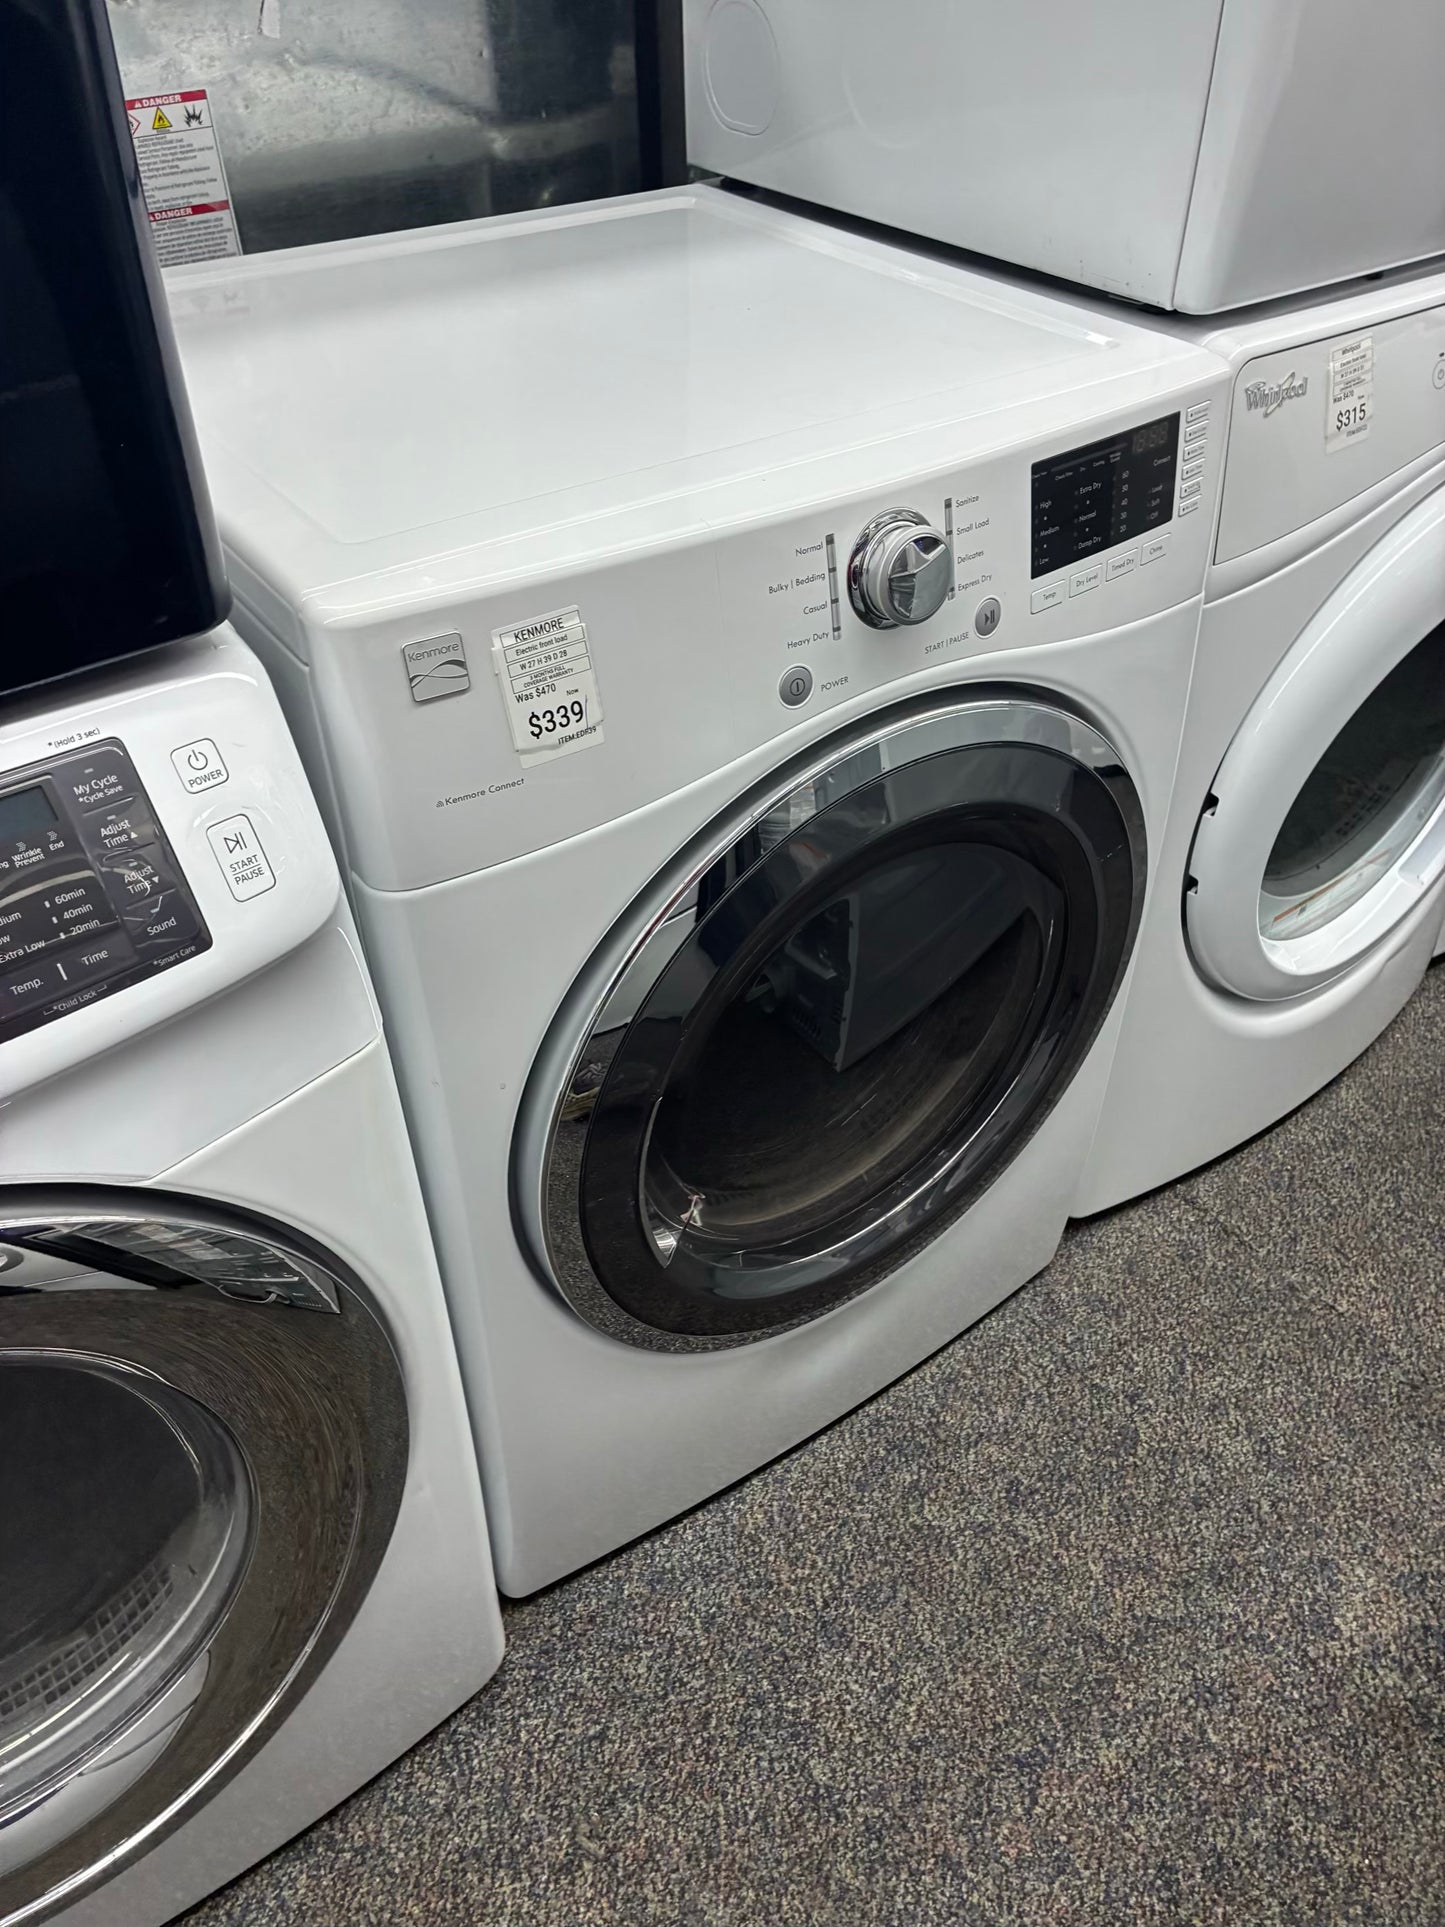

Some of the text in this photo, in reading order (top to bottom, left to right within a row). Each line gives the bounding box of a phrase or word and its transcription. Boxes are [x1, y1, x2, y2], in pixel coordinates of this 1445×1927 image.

[142, 94, 182, 108] DANGER
[154, 207, 193, 220] DANGER
[1244, 371, 1309, 418] Whirlpool
[1336, 402, 1366, 432] $315
[1092, 482, 1102, 490] Dry
[955, 495, 980, 508] Sanitize
[956, 518, 990, 536] Small Load
[795, 542, 824, 557] Normal
[957, 550, 984, 565] Delicates
[1126, 558, 1135, 567] Dry
[768, 572, 826, 594] Bulky Bedding
[958, 574, 993, 592] Express Dry
[1042, 592, 1056, 601] Temp
[803, 601, 828, 615] Casual
[514, 617, 564, 643] KENMORE
[516, 634, 568, 657] Electric front load
[786, 631, 830, 650] Heavy Duty
[924, 632, 970, 655] START PAUSE
[408, 642, 460, 663] Kenmore
[528, 660, 536, 669] 27
[537, 658, 542, 666] H
[544, 654, 552, 664] 39
[553, 652, 558, 660] D
[559, 649, 568, 658] 28
[524, 668, 574, 688] COVERAGE WARRANTY
[533, 668, 554, 680] MONTHS
[554, 665, 566, 673] FULL
[566, 688, 579, 696] Now
[820, 676, 850, 692] POWER
[514, 683, 556, 704] Was $470
[528, 700, 584, 740] $339
[54, 728, 100, 749] (Hold 3 sec)
[73, 774, 118, 796] My Cycle
[188, 768, 224, 788] POWER
[104, 784, 124, 796] Save
[444, 778, 525, 806] Kenmore Connect
[100, 818, 132, 838] Adjust
[48, 840, 64, 851] End
[103, 833, 128, 849] Time
[12, 847, 42, 862] Wrinkle
[14, 853, 46, 868] Prevent
[229, 854, 259, 873] START
[124, 864, 154, 884] Adjust
[234, 866, 265, 886] PAUSE
[126, 878, 152, 895] Time
[54, 888, 86, 905] 60min
[63, 903, 93, 920] 40min
[70, 919, 100, 936] 20min
[146, 916, 178, 936] Sound
[24, 940, 46, 953] Low
[180, 945, 197, 956] Care
[81, 949, 110, 966] Time
[10, 978, 44, 996] Temp.
[79, 990, 98, 1002] Lock
